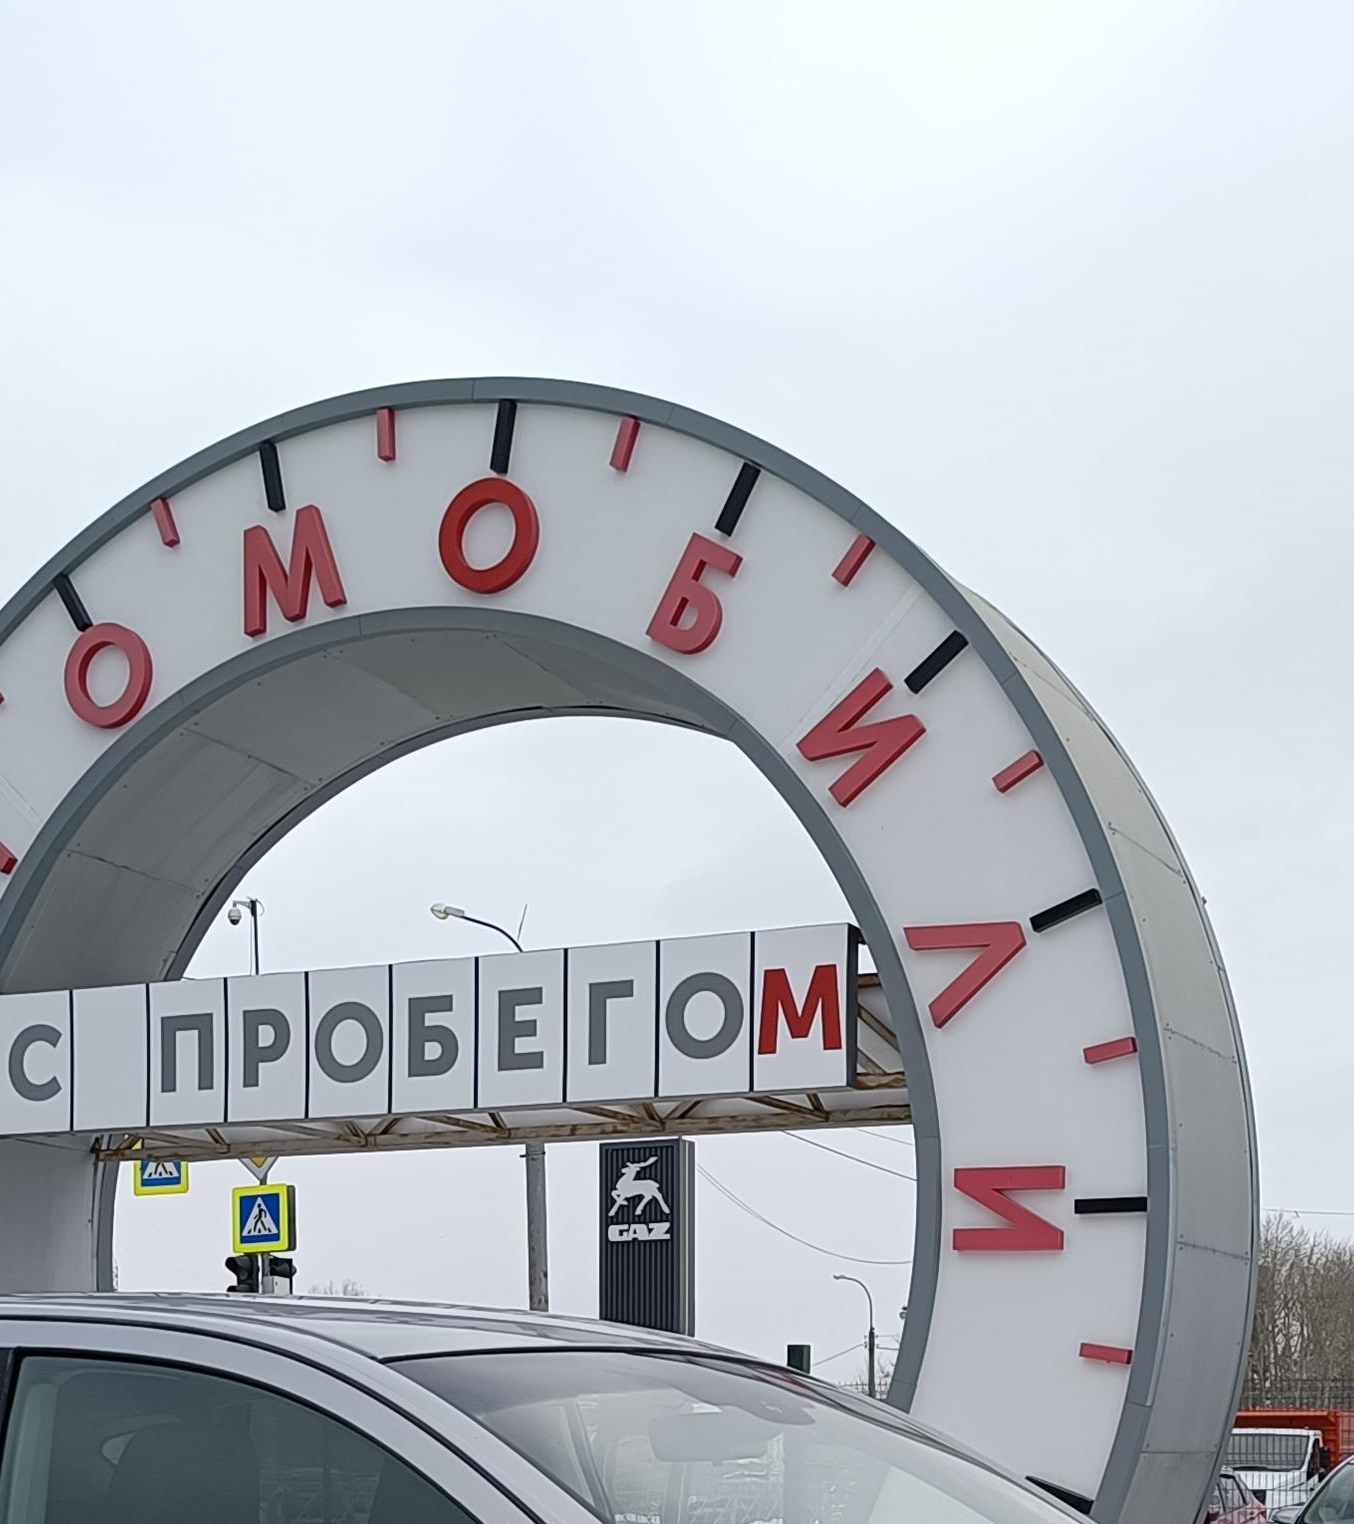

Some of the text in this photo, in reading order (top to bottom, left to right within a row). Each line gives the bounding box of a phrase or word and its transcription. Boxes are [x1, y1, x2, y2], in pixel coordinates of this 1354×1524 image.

[8, 964, 844, 1101] С ПРОБЕГОМ
[607, 1221, 671, 1242] GAZ
